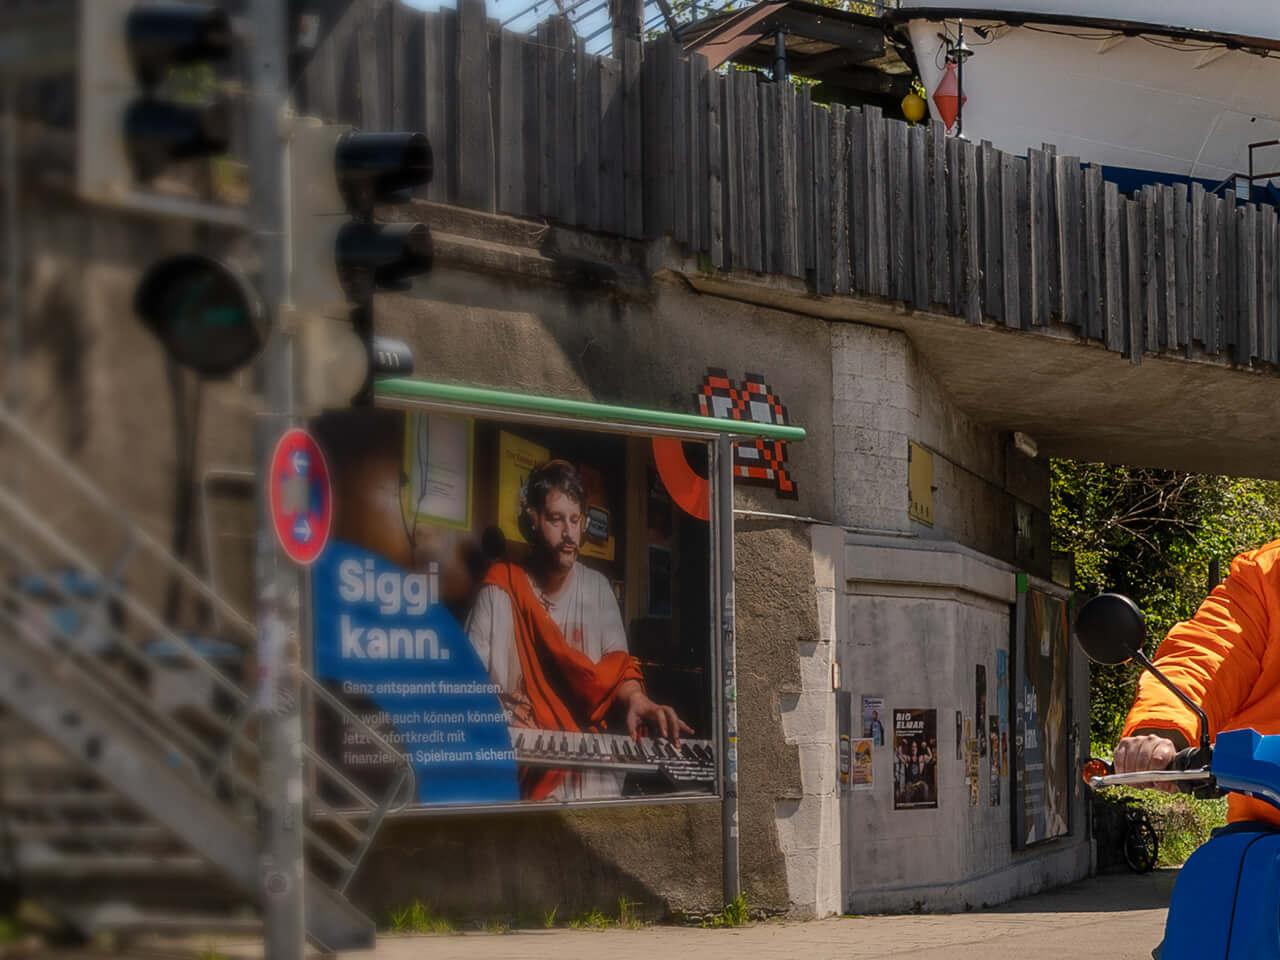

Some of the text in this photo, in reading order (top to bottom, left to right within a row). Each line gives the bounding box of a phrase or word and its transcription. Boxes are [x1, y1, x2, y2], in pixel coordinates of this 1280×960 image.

[339, 557, 440, 616] Siggi
[340, 614, 451, 661] kann.
[342, 679, 505, 697] Ganz entspannt finanzieren.
[393, 711, 421, 725] auch
[423, 710, 465, 724] können
[375, 729, 444, 745] ofortkredit
[446, 729, 466, 743] mit
[415, 750, 474, 766] Spielraum
[475, 747, 519, 762] sichern!
